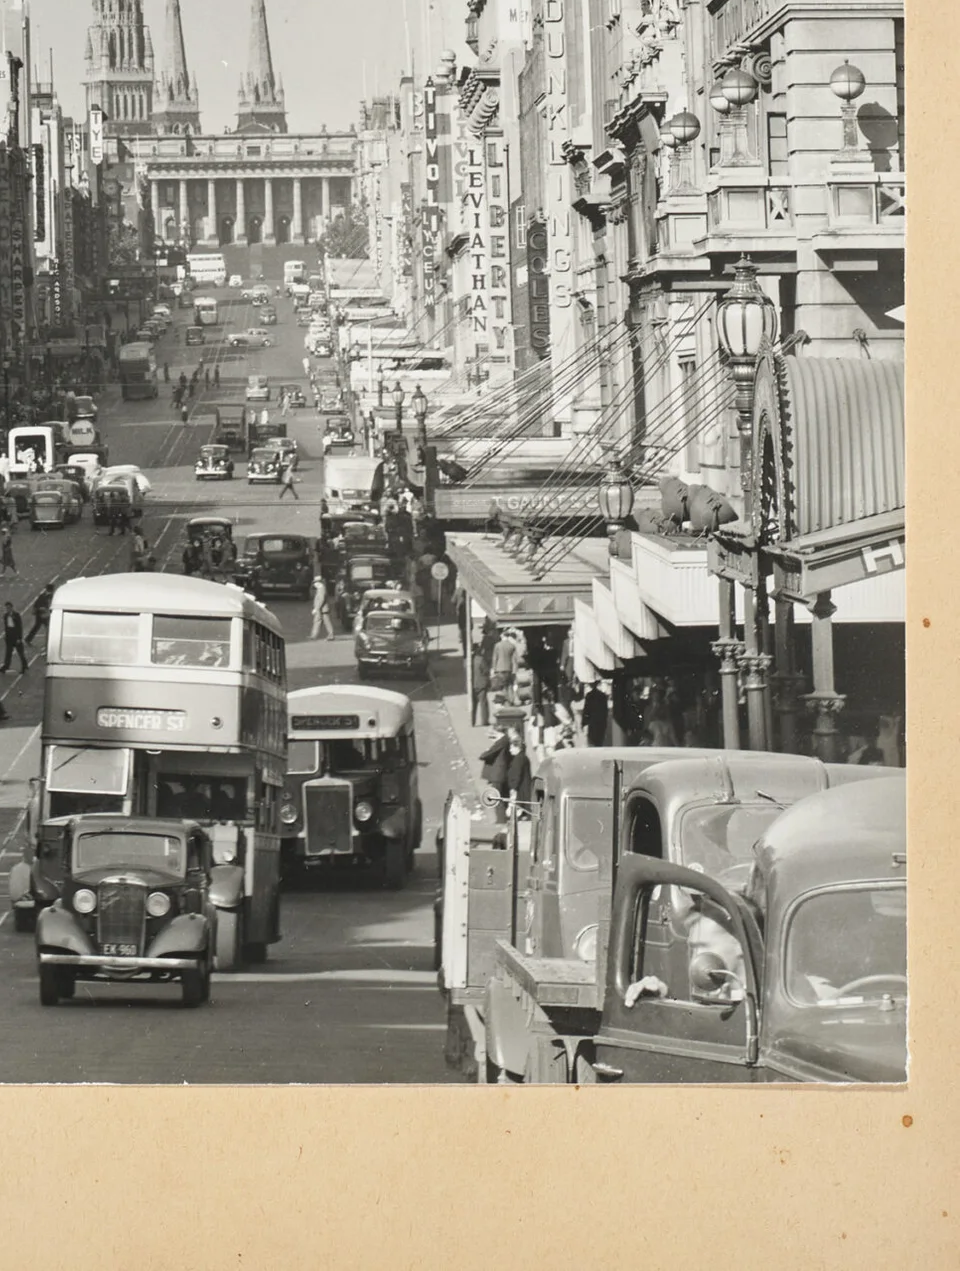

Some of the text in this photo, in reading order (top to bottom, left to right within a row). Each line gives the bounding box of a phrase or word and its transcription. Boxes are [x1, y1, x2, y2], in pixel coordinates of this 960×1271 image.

[92, 112, 103, 158] TYE
[424, 87, 439, 232] TIVOLI
[422, 211, 435, 305] LYCEUM
[468, 150, 487, 332] LEVIATHAN
[488, 143, 508, 350] LIBERTY
[529, 232, 550, 348] COLES
[99, 712, 187, 731] SPENCER ST
